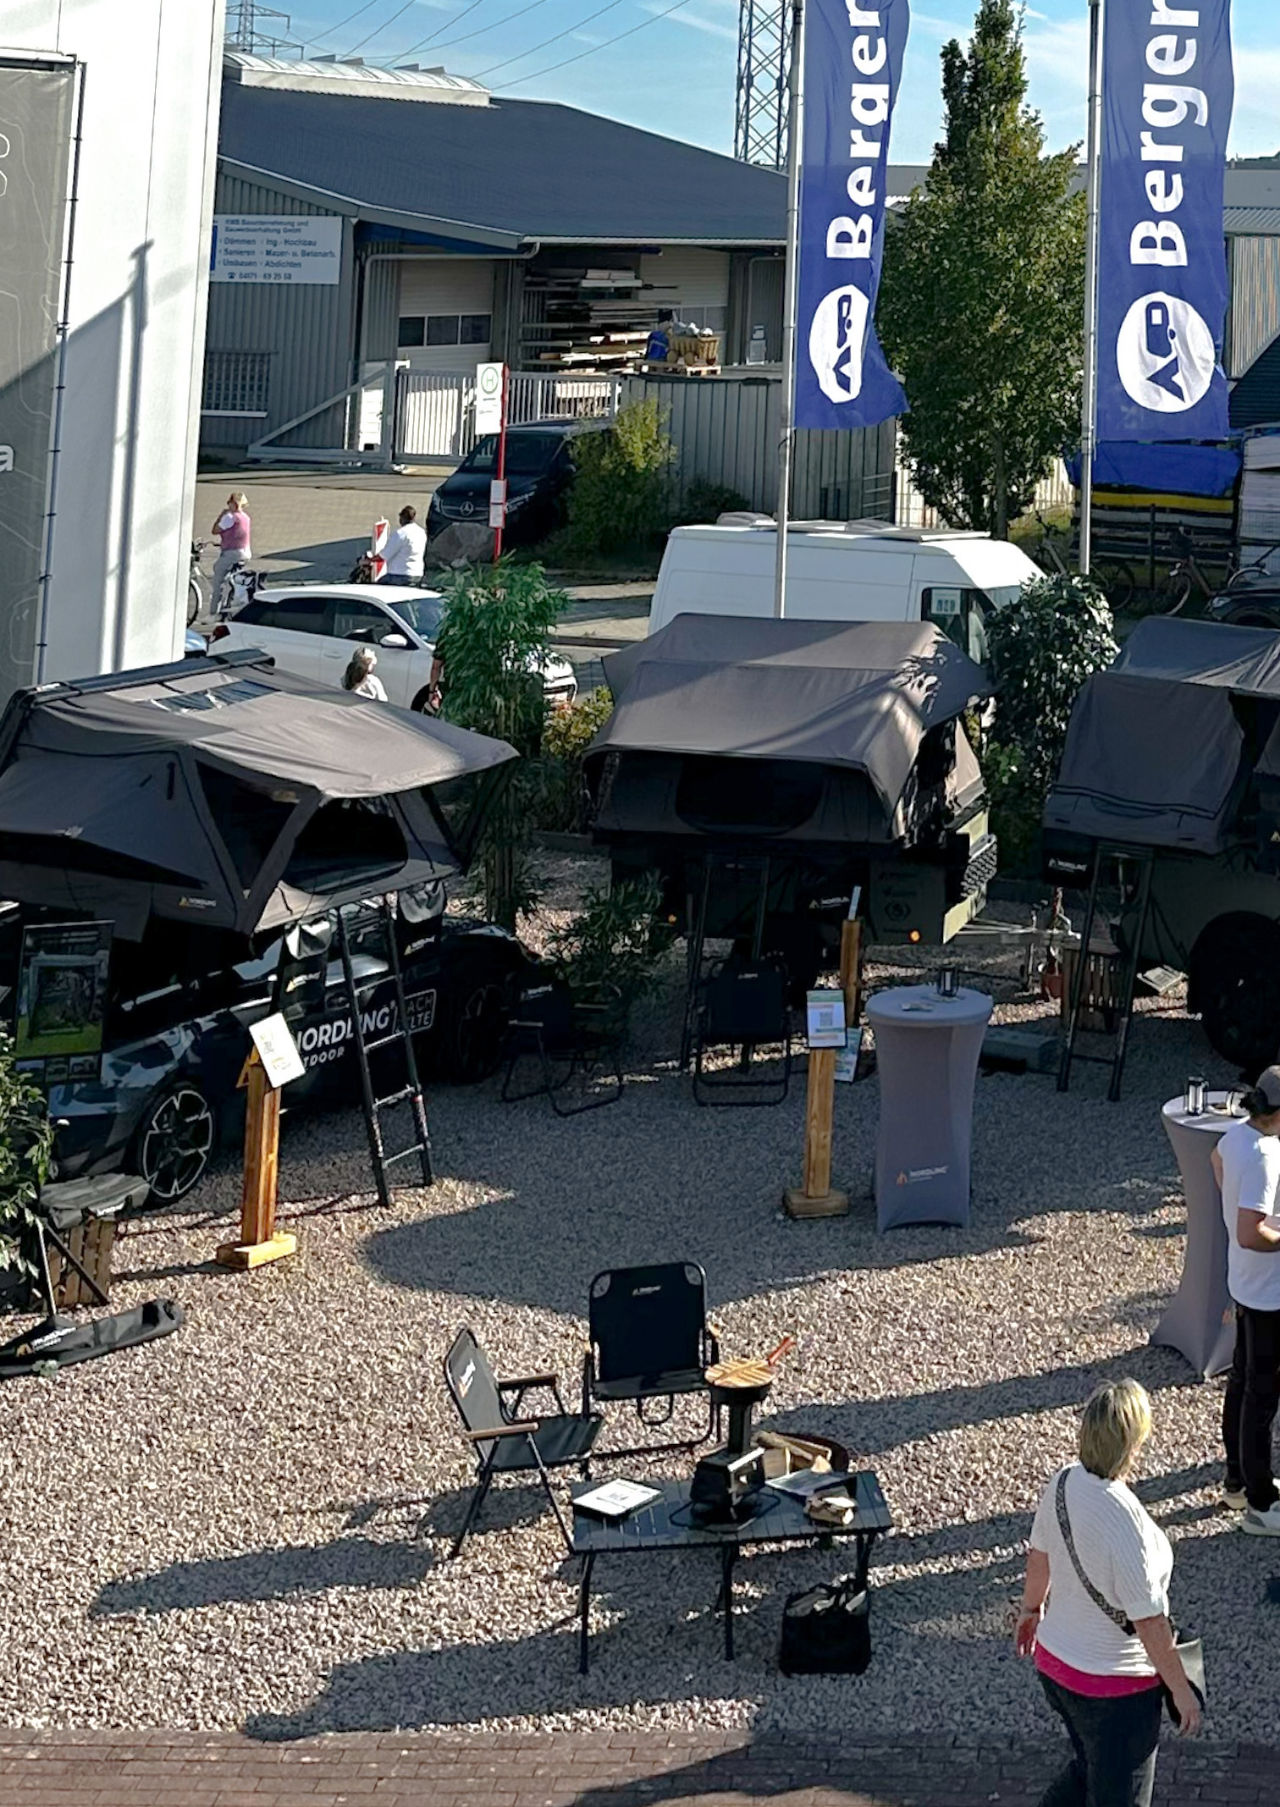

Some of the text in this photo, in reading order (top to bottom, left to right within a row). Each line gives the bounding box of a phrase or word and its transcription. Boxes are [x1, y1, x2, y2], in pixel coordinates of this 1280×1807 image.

[1130, 0, 1208, 267] Berger
[224, 248, 255, 256] Sanieren
[264, 260, 302, 268] Abdichten
[406, 996, 433, 1013] ACH
[410, 1010, 431, 1028] LTE
[302, 1046, 345, 1069] TDOOR
